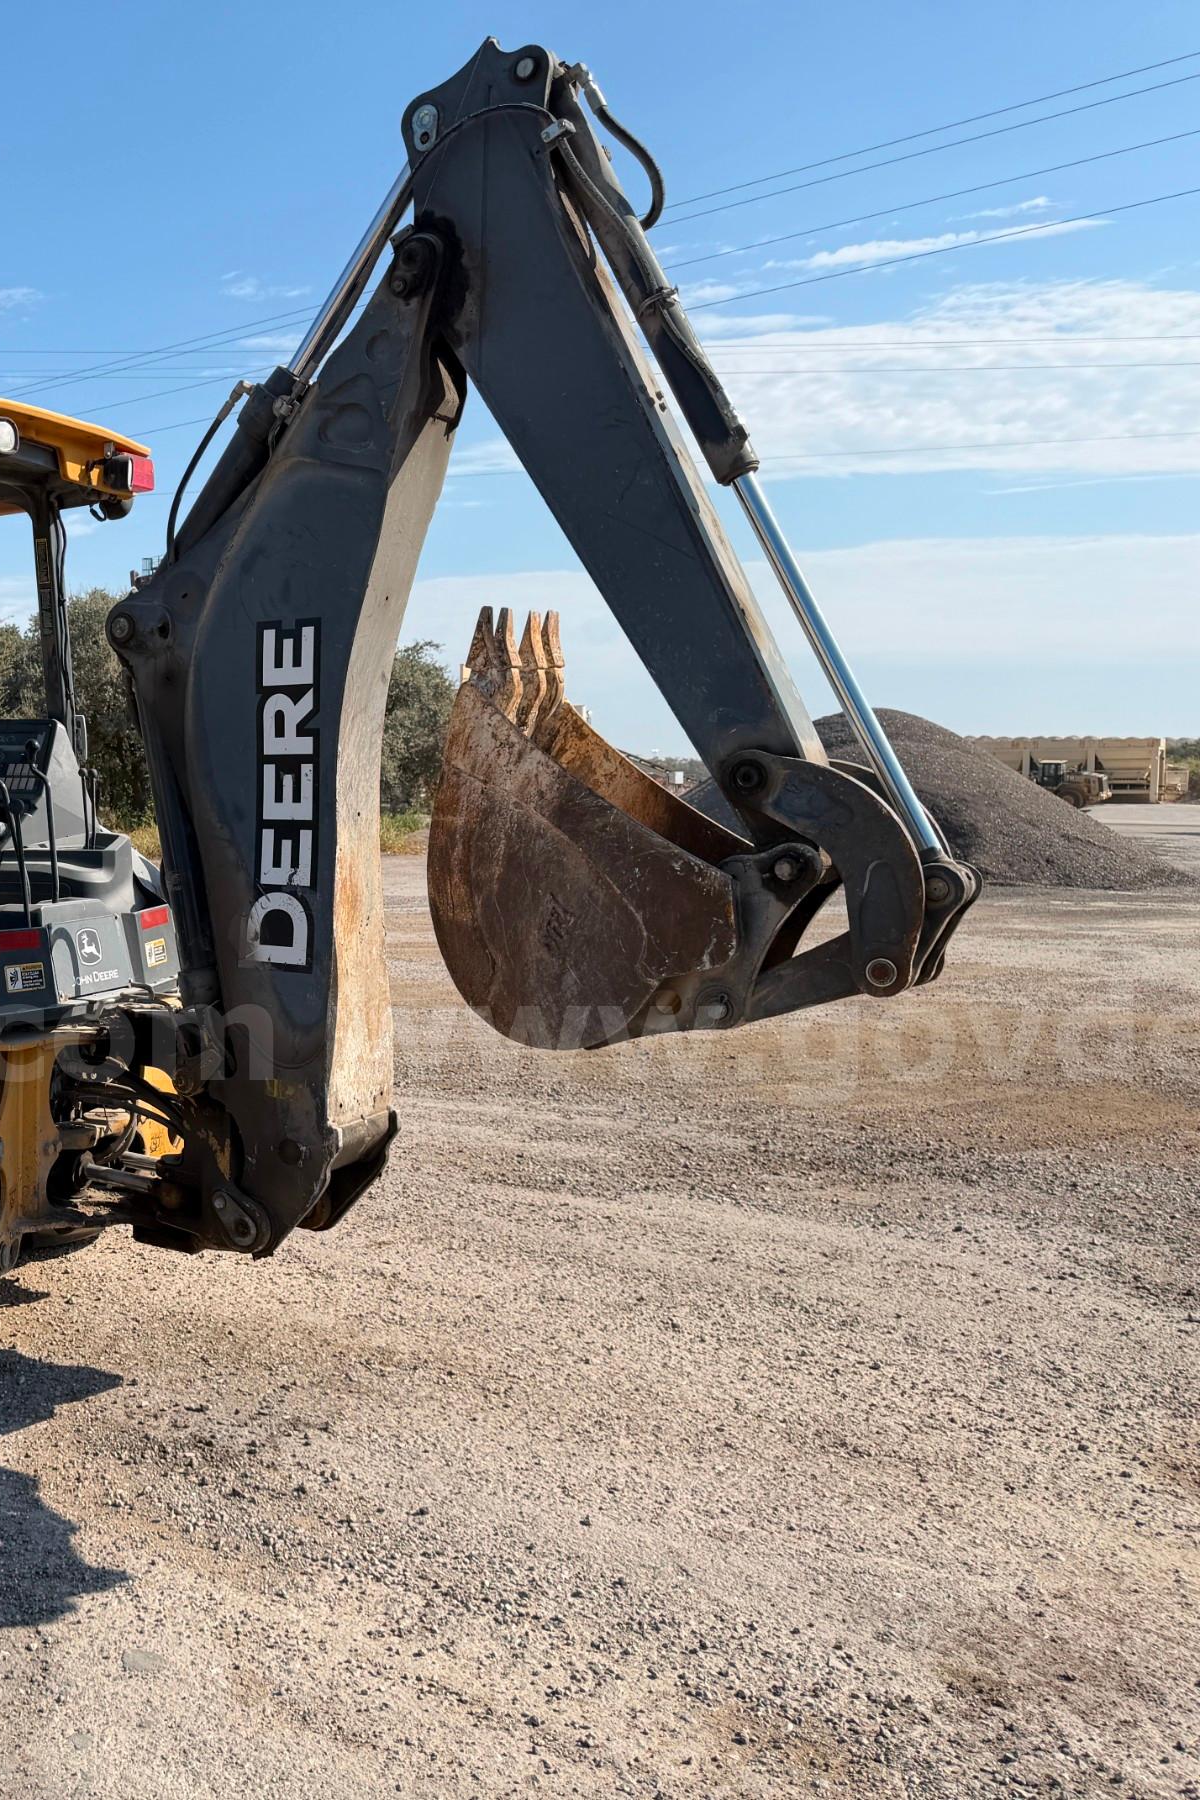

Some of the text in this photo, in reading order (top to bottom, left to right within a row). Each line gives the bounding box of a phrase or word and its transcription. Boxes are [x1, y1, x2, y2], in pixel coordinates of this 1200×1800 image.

[246, 625, 315, 966] DEERE
[71, 969, 120, 988] JOHN DEERE
